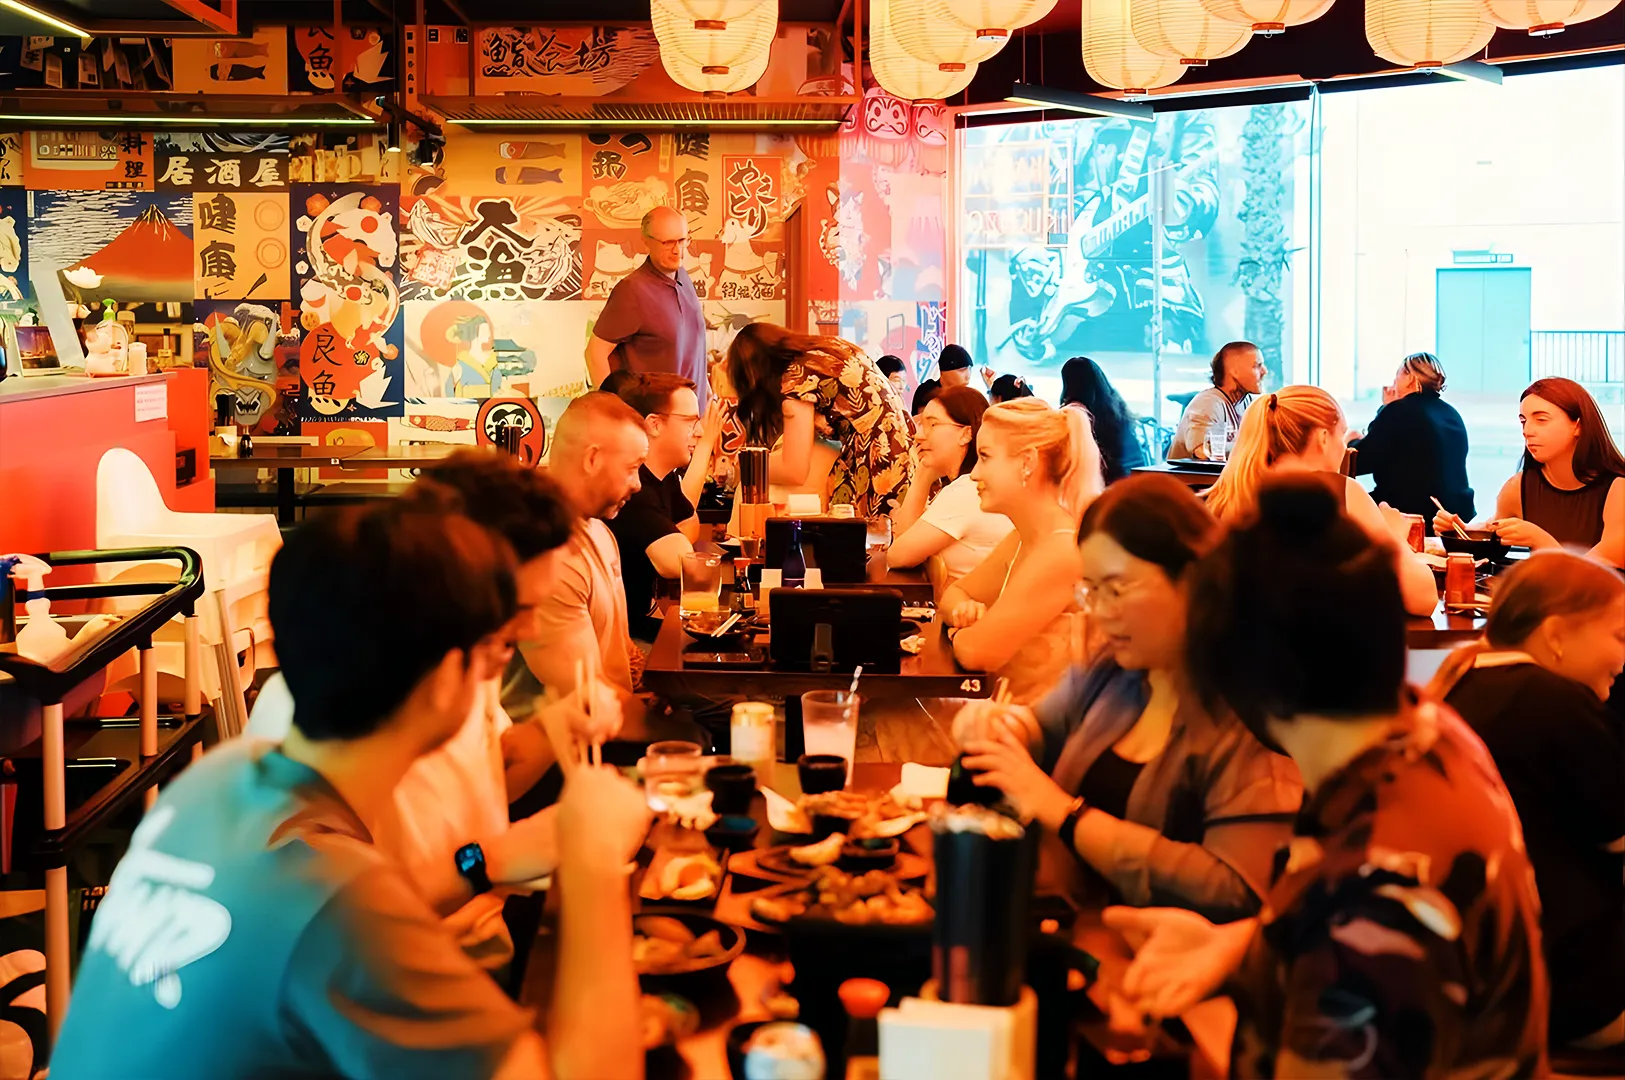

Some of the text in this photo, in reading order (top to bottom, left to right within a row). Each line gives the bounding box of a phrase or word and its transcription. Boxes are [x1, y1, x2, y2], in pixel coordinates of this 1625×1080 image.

[157, 156, 286, 187] 居酒屋
[311, 328, 345, 408] 良魚
[960, 679, 981, 692] 43
